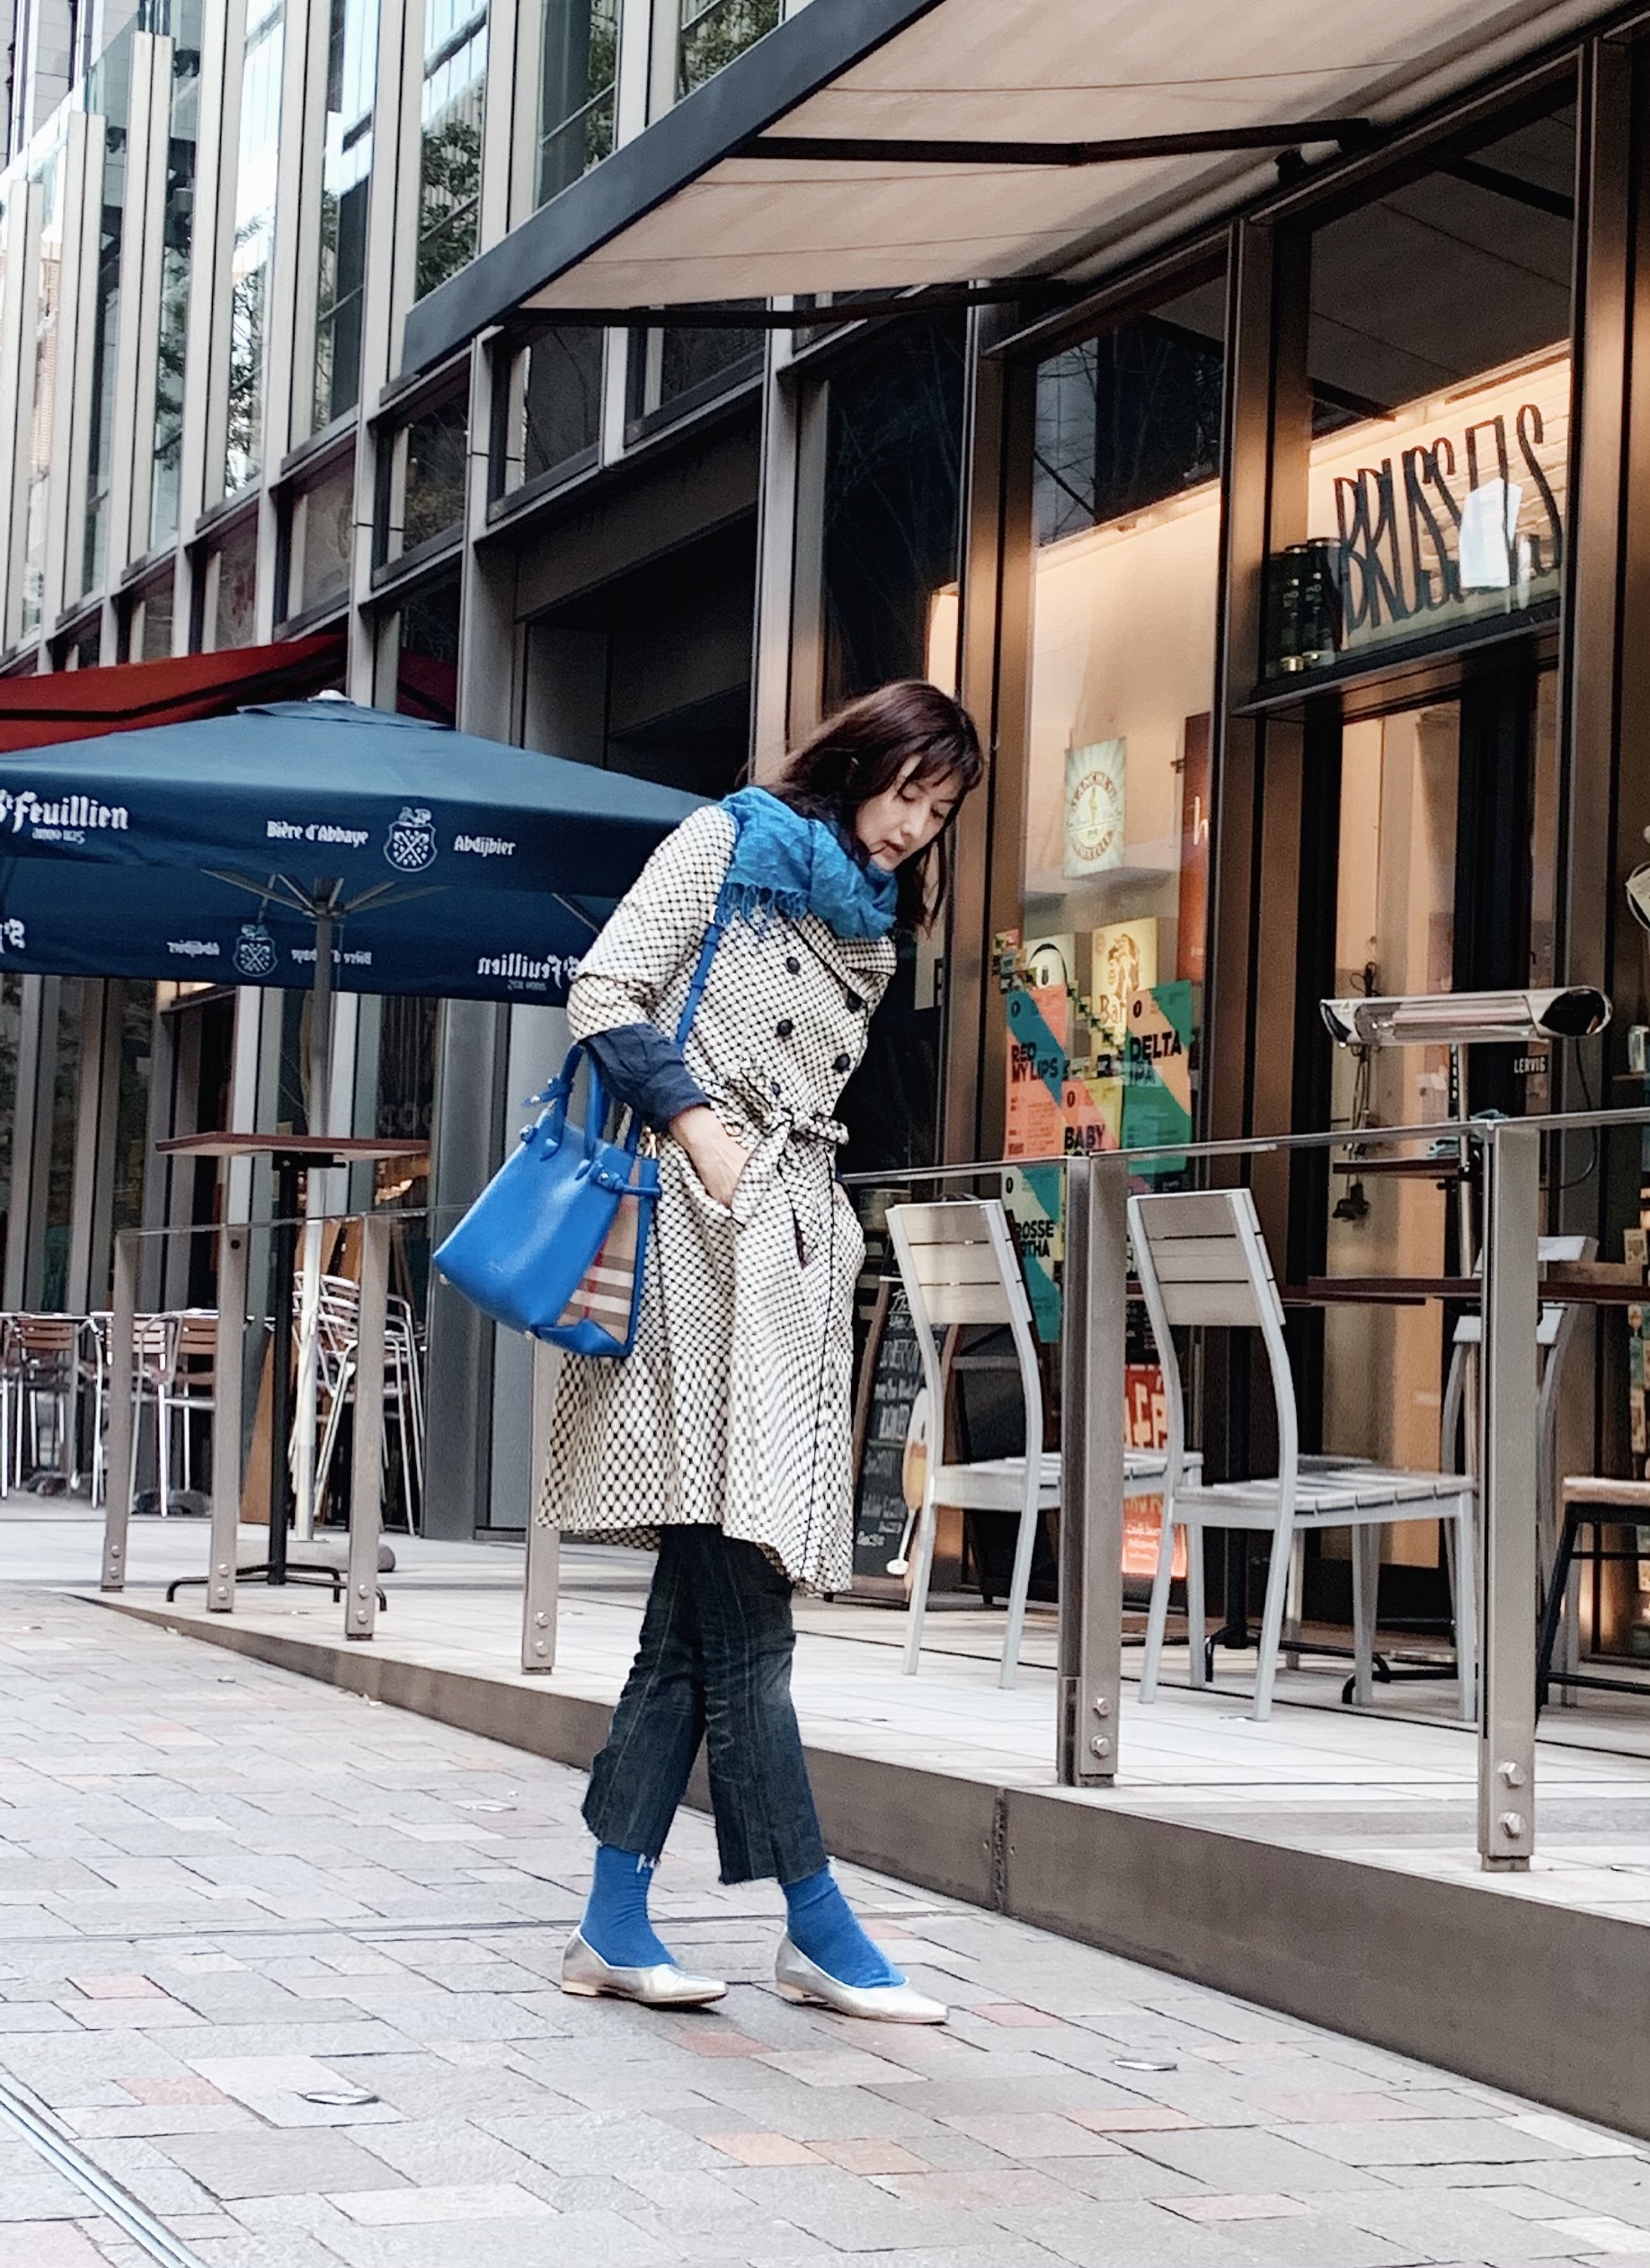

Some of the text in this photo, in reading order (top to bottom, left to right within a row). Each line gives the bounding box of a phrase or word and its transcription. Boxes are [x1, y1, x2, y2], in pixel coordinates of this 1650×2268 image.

[12, 791, 129, 829] Feuillien
[453, 835, 517, 857] Abdijbier
[1011, 1042, 1036, 1063] RED
[1130, 1031, 1182, 1061] DELTA
[1064, 1124, 1105, 1149] BABY
